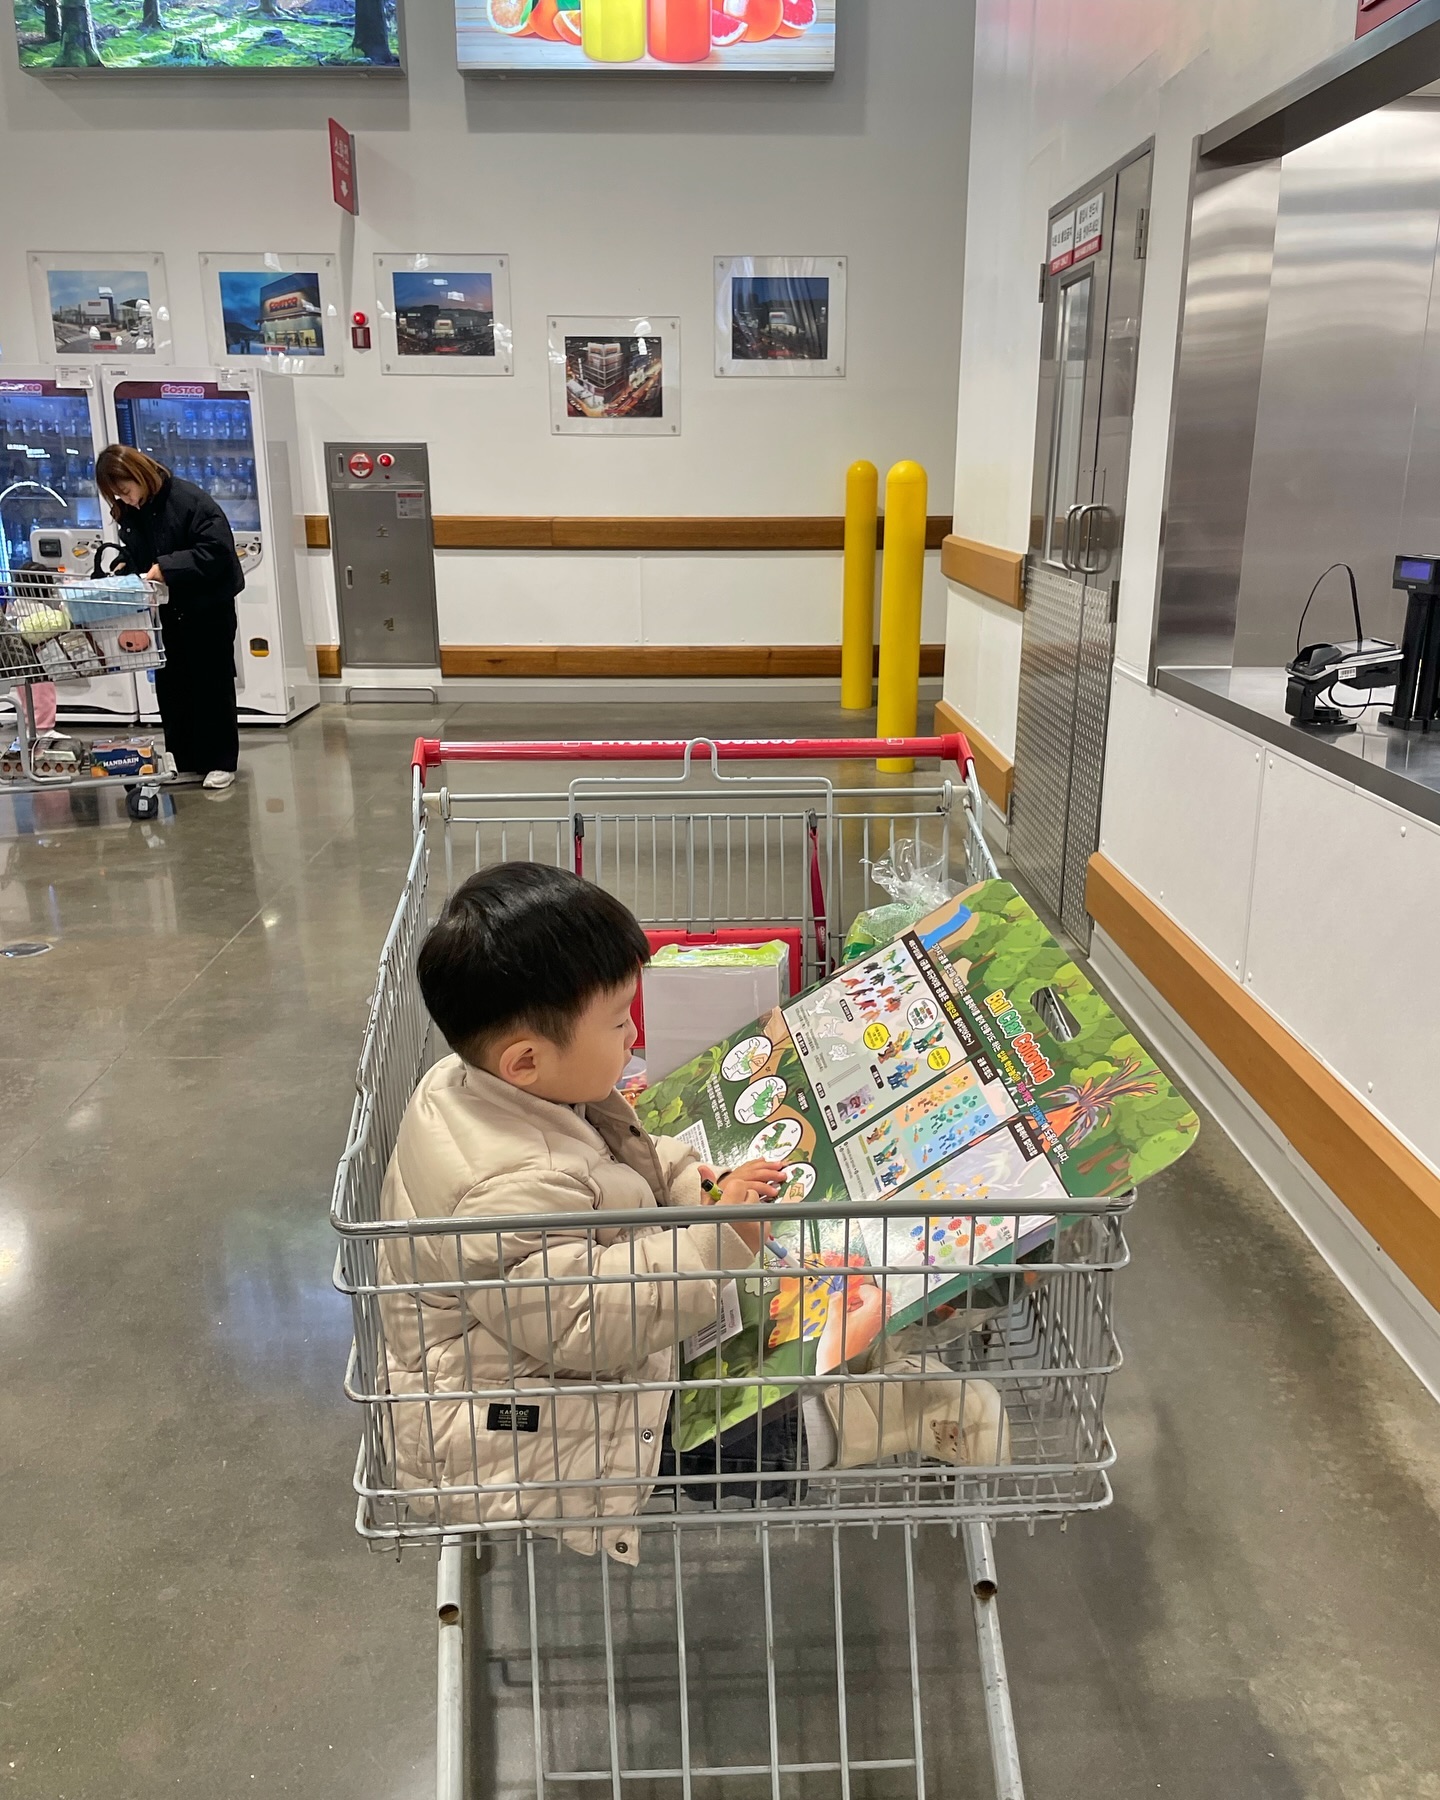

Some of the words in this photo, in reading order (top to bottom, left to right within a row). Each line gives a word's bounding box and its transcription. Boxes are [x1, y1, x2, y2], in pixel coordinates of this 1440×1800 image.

[161, 384, 204, 394] COSTCO
[103, 757, 139, 767] MANDARIN
[937, 952, 949, 965] 공룡
[924, 968, 941, 989] 피규어와
[934, 985, 950, 1003] 공룡은
[942, 999, 960, 1020] 랜덤으로
[984, 988, 1010, 1017] Ball
[962, 993, 981, 1017] 볼클레이를
[974, 1013, 986, 1025] 붙여
[996, 1009, 1027, 1039] Clay
[979, 1022, 997, 1043] 만들기도
[989, 1039, 1003, 1053] 하는
[995, 1049, 1009, 1063] 입체
[976, 1056, 987, 1067] 공룡
[1010, 1032, 1056, 1087] Coloring
[1014, 1080, 1036, 1107] 지능개발과
[1029, 1103, 1050, 1130] 감성발달에
[1013, 1121, 1029, 1140] 볼클레이
[1022, 1137, 1038, 1157] 컬러조합
[1043, 1127, 1060, 1146] 도움이
[1052, 1142, 1070, 1164] 됩니다.
[1001, 1226, 1012, 1241] 초록색
